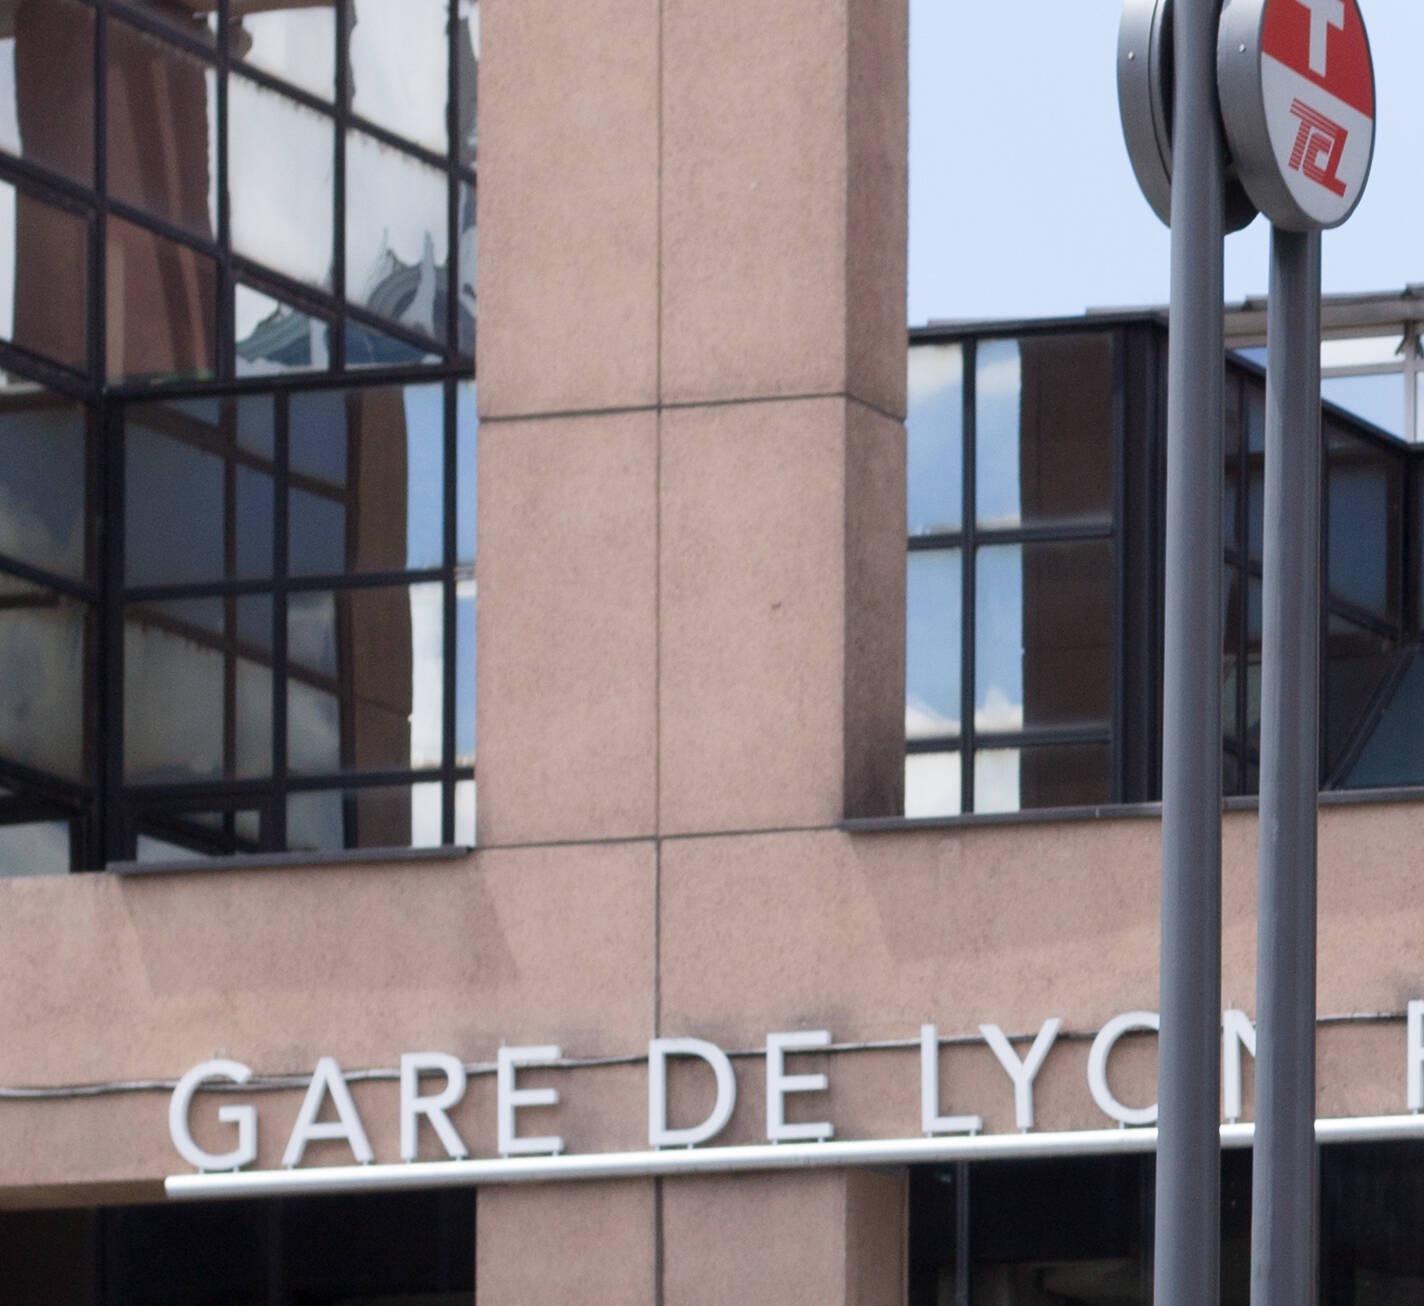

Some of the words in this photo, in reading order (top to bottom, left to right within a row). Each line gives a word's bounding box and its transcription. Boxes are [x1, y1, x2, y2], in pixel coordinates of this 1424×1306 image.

[1288, 97, 1349, 198] TCL
[168, 1044, 565, 1172] GARE
[648, 1030, 835, 1147] DE
